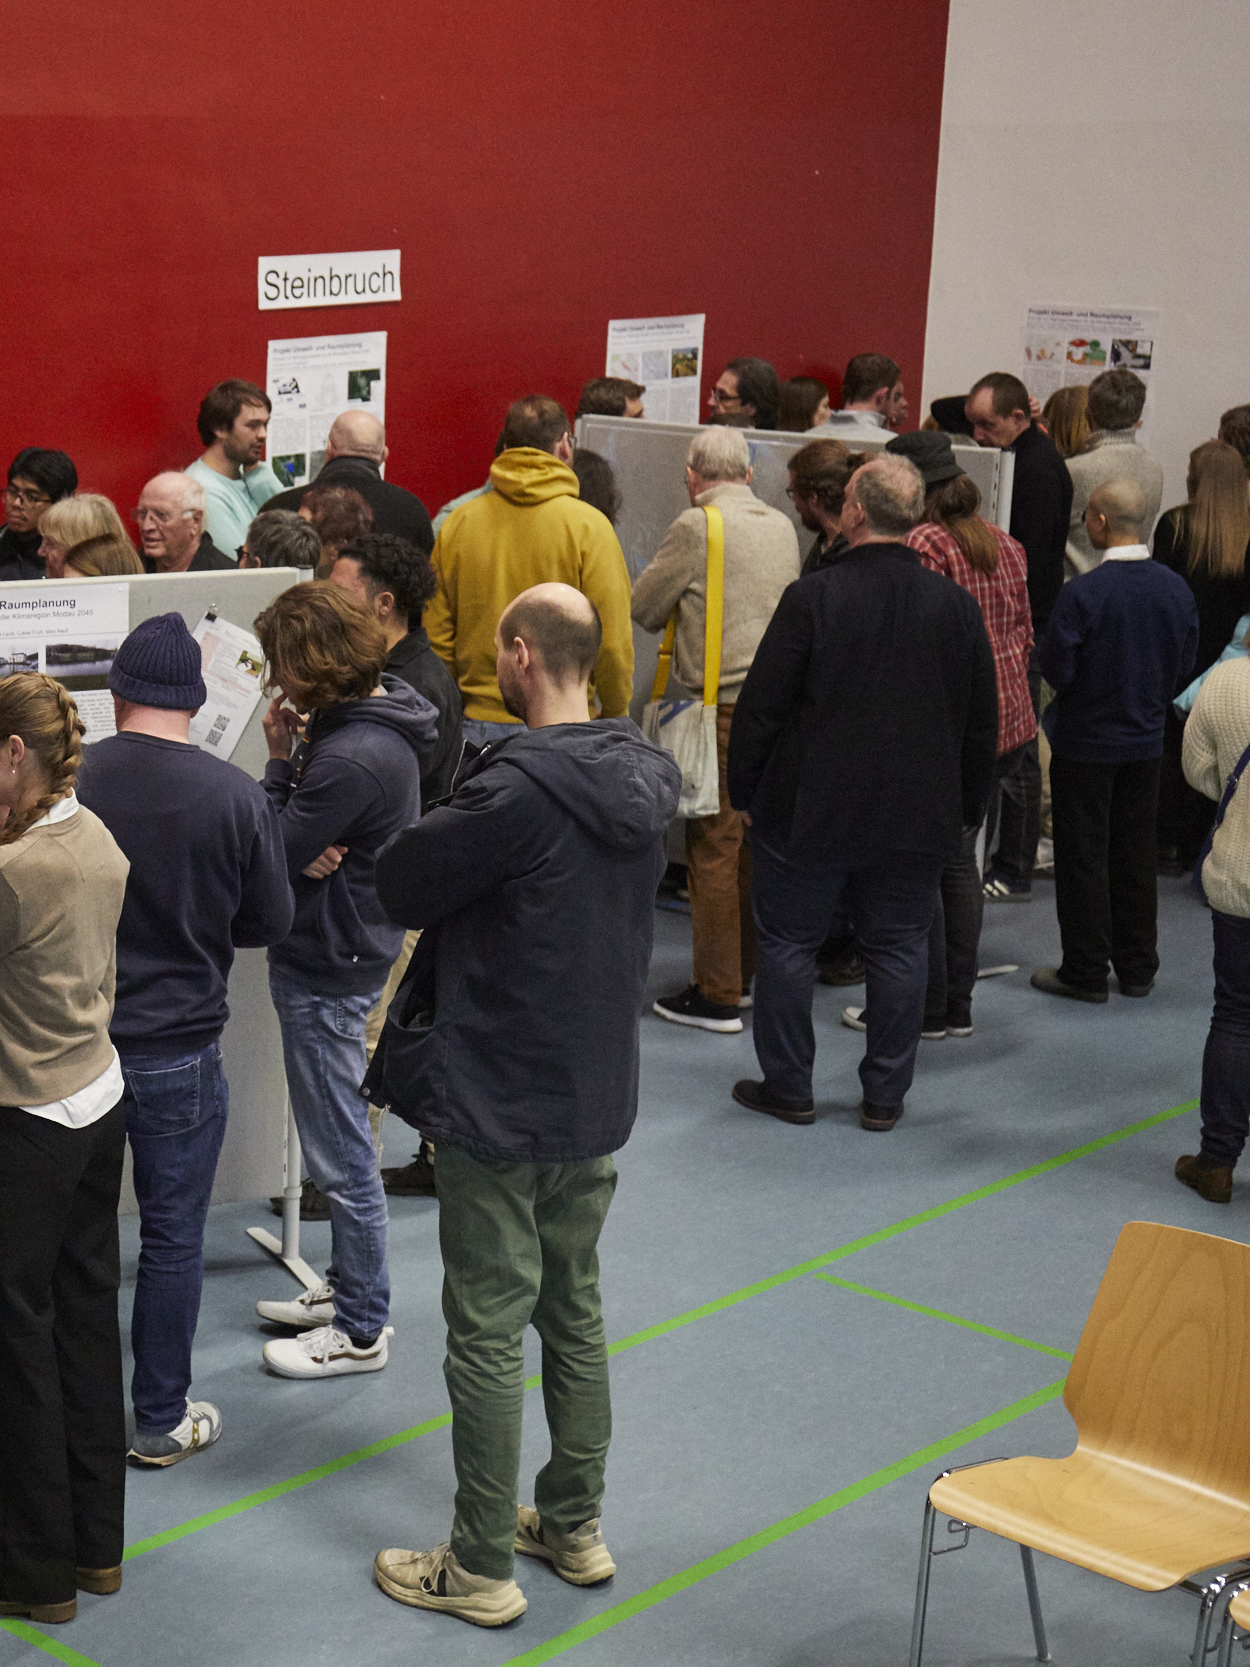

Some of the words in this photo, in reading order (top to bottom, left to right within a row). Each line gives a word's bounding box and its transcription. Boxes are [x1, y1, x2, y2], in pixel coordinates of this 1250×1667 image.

[263, 263, 395, 301] Steinbruch
[0, 598, 76, 611] Raumplanung
[12, 611, 51, 620] Klimaregion
[52, 610, 76, 618] Modau
